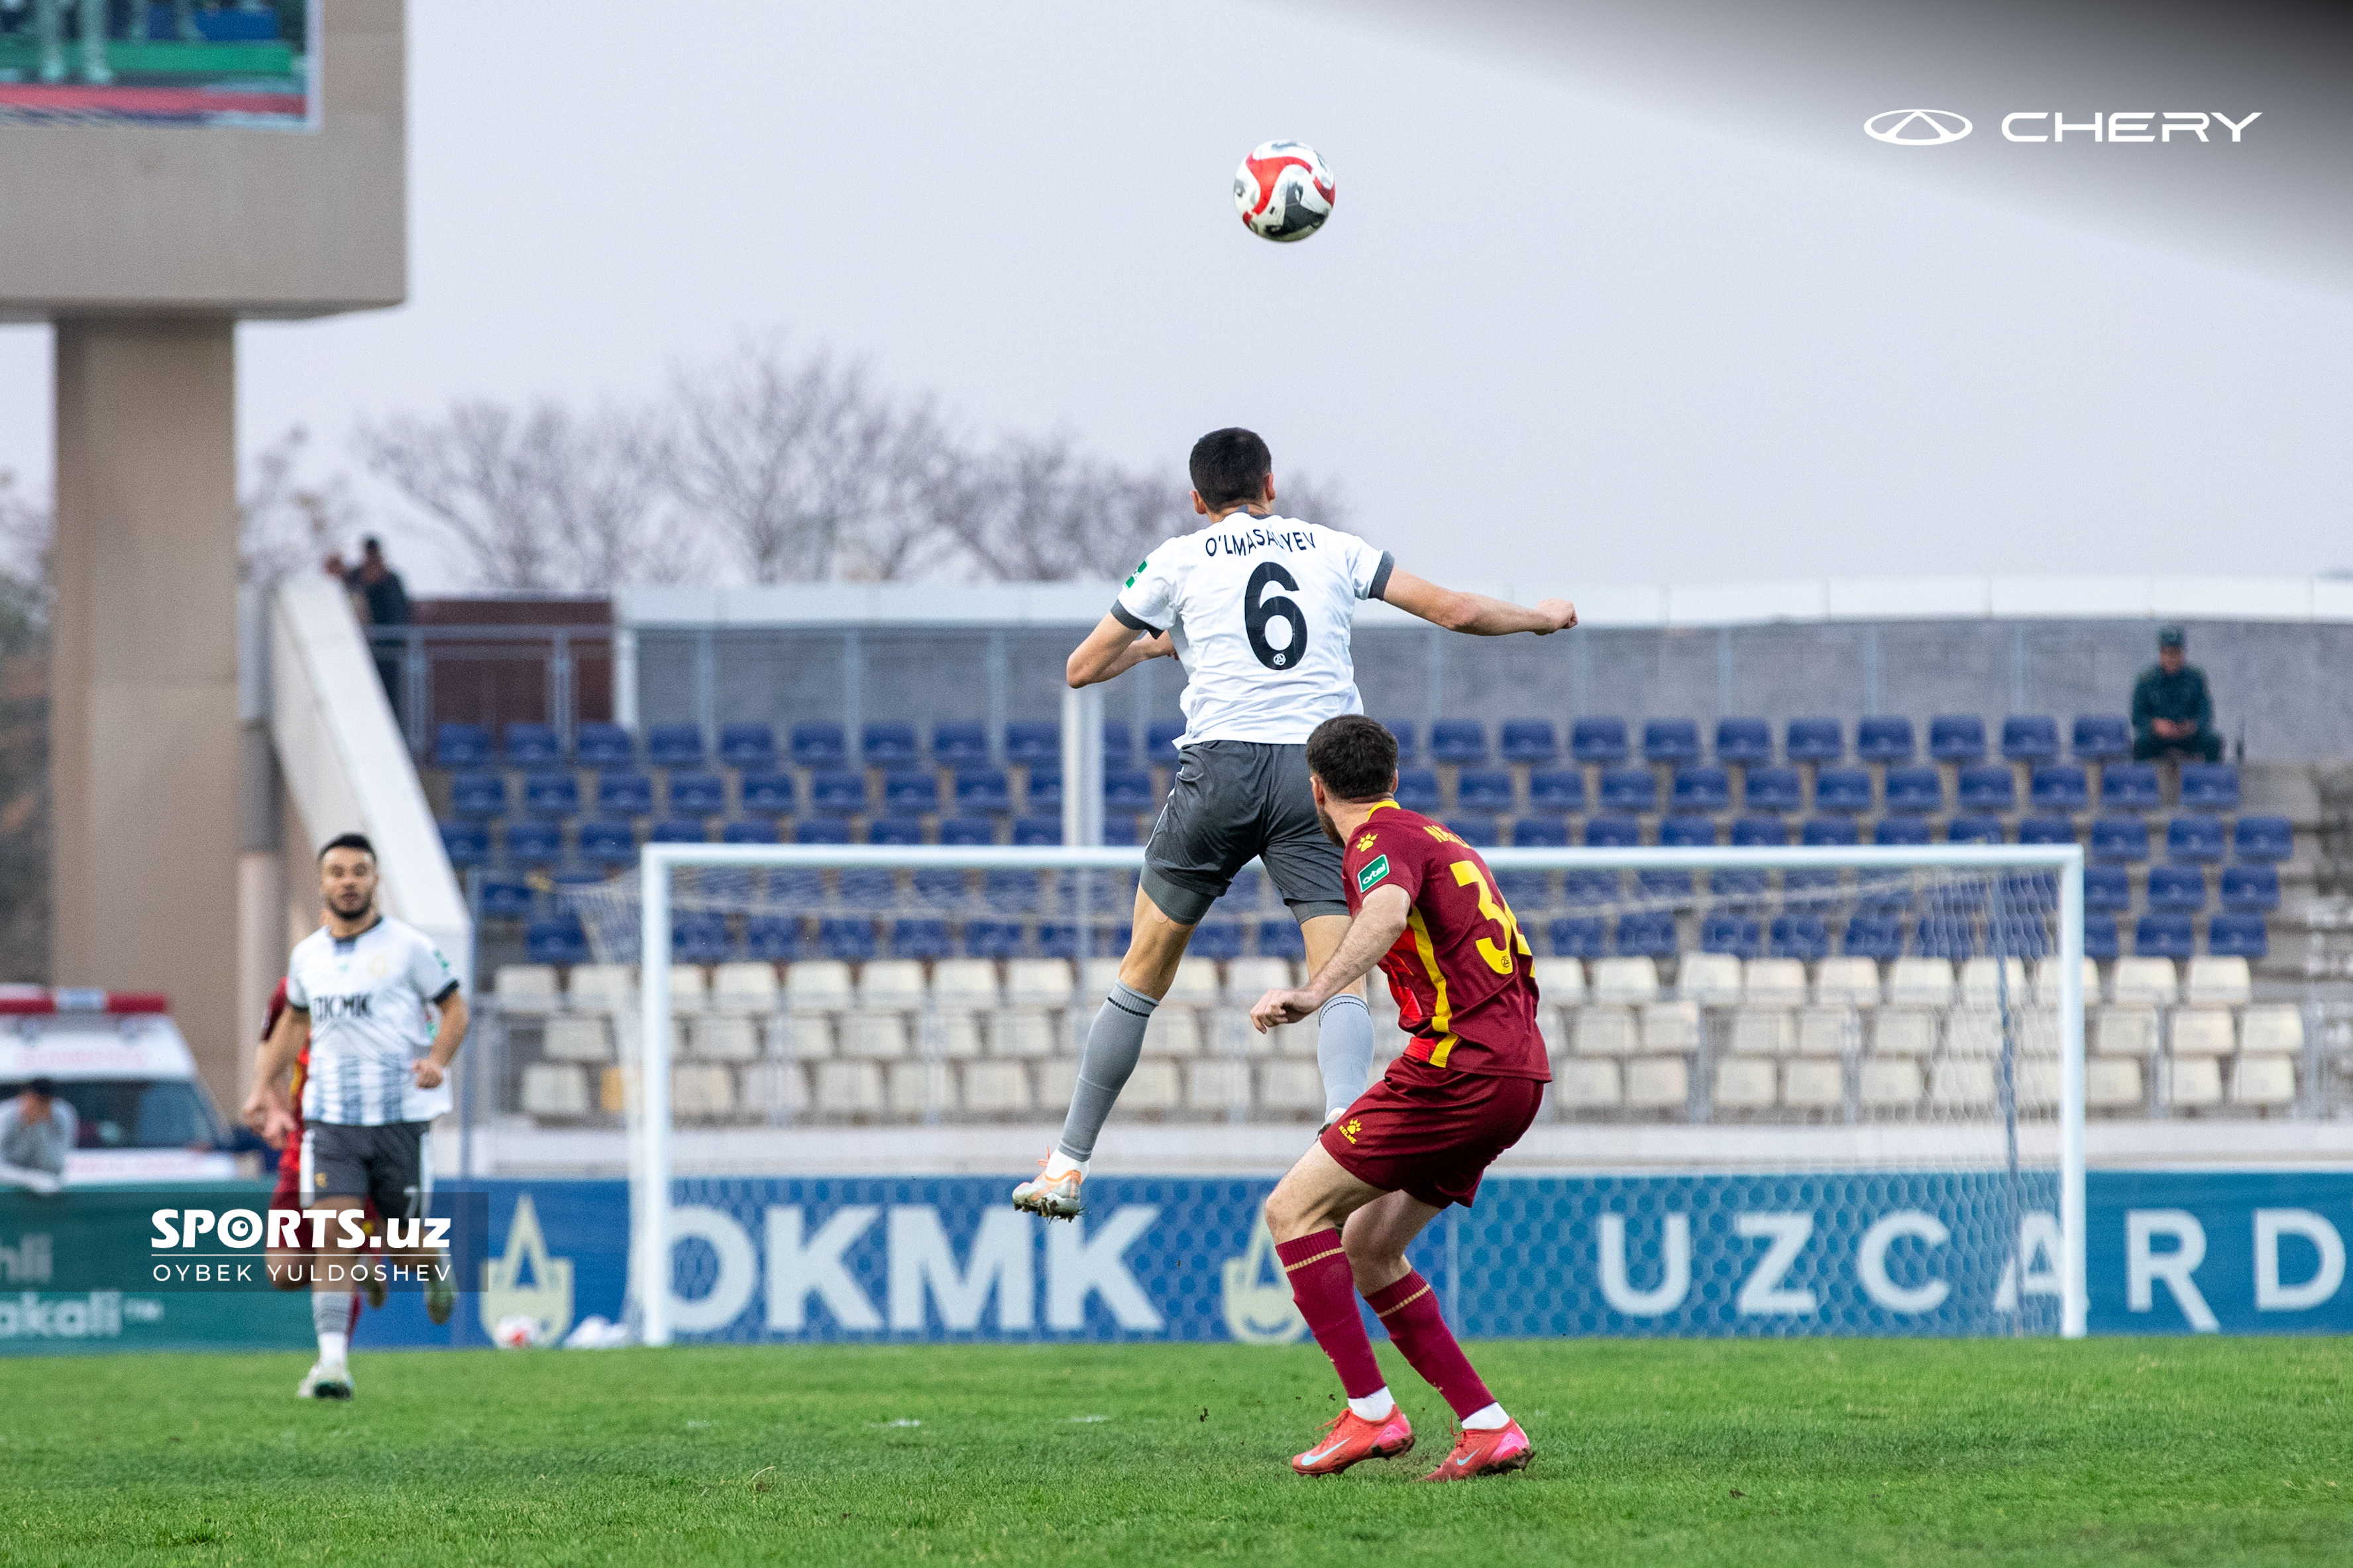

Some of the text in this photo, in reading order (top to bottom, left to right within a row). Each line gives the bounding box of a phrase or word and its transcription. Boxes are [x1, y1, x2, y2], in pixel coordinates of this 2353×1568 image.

[1244, 561, 1308, 670] 6
[1362, 862, 1386, 884] artel
[661, 1204, 1165, 1331] OKMK
[1598, 1207, 2347, 1332] UZCARD
